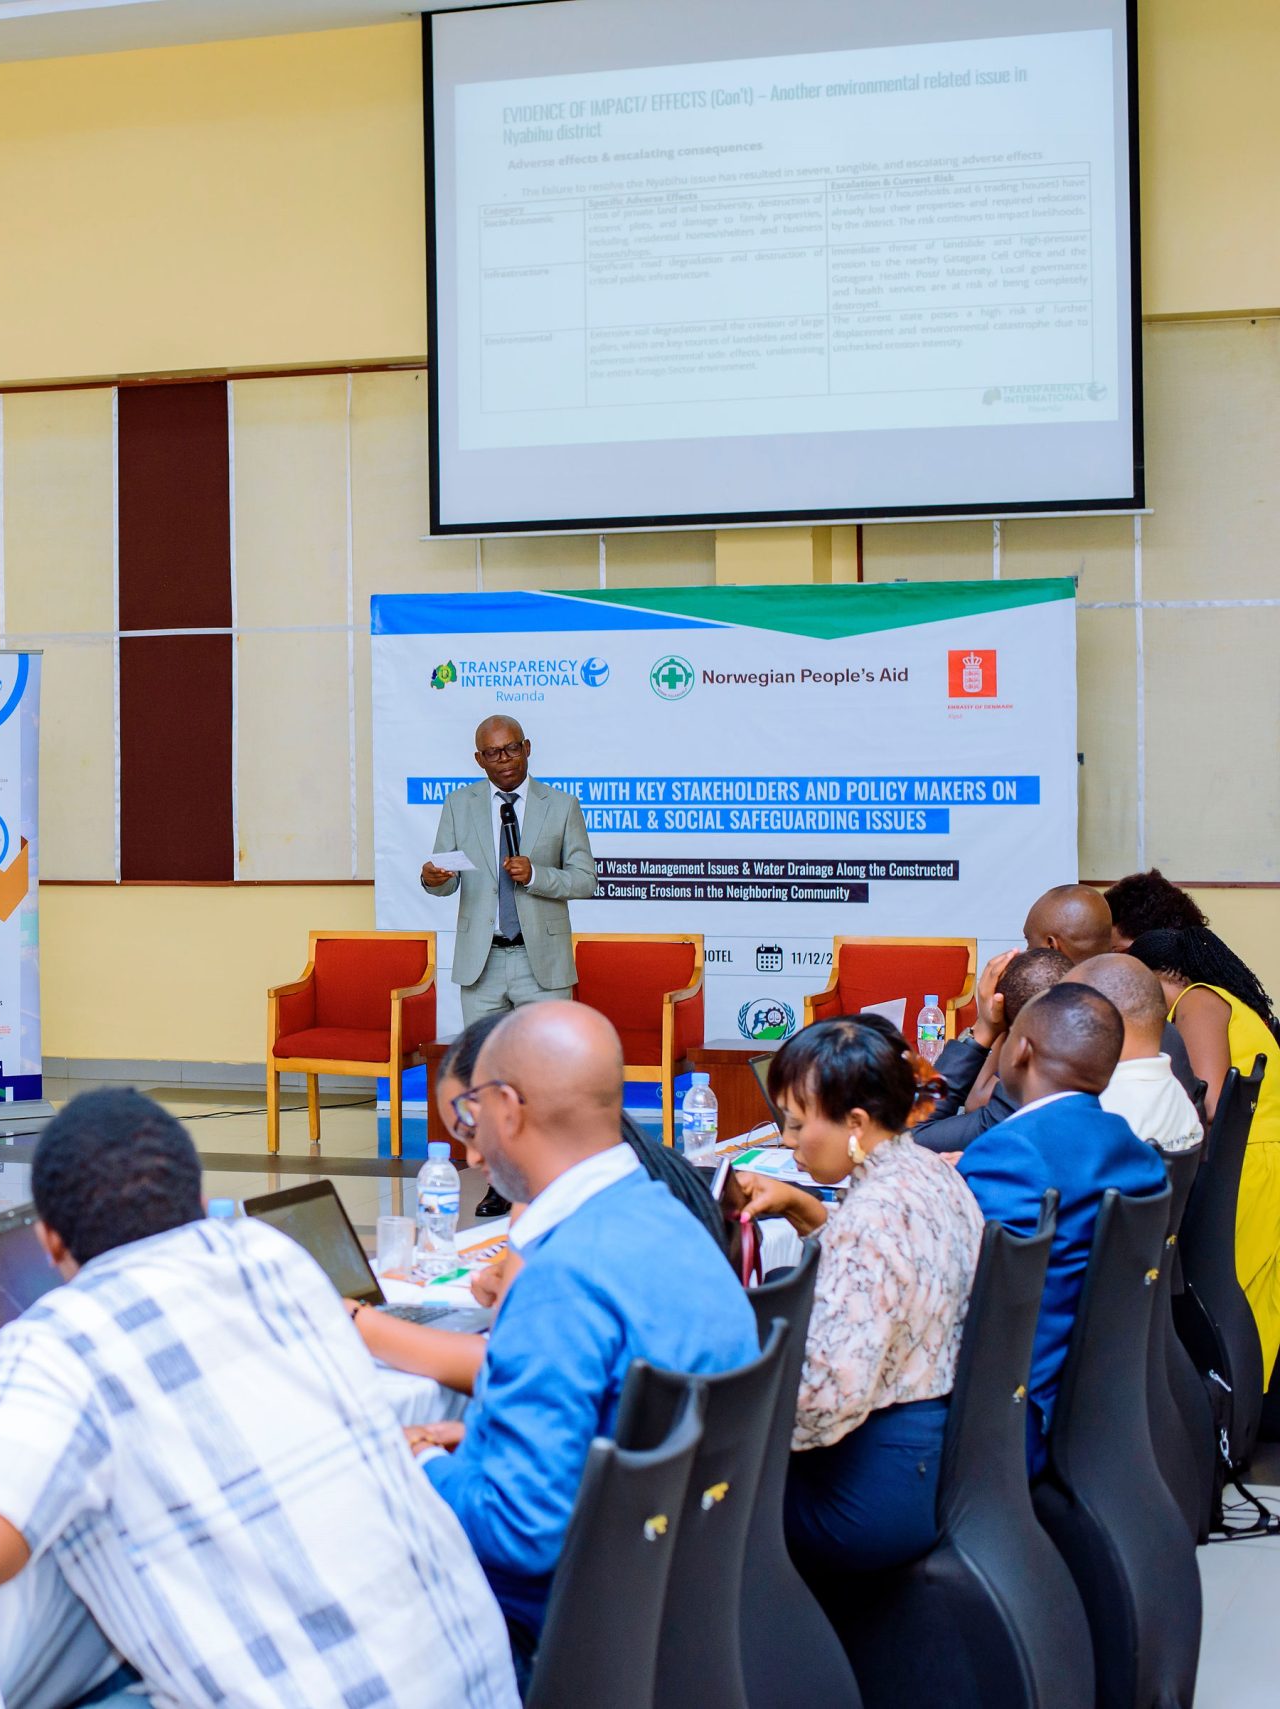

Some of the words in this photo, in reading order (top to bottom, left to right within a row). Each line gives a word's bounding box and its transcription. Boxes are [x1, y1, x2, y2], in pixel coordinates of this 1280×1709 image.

[503, 102, 565, 124] EVIDENCE
[570, 100, 586, 118] OF
[590, 95, 646, 116] IMPACT/
[651, 91, 706, 111] EFFECTS
[770, 81, 821, 101] Another
[825, 73, 919, 97] environmental
[924, 68, 970, 89] related
[975, 66, 1009, 85] issue
[1014, 64, 1026, 82] in
[503, 125, 552, 146] Nyabihu
[556, 121, 602, 141] district
[508, 156, 554, 170] Adverse
[558, 152, 598, 165] effects
[602, 152, 609, 162] &
[613, 146, 674, 164] escalating
[677, 141, 763, 158] consequences
[521, 187, 539, 197] The
[542, 184, 571, 195] failure
[575, 184, 586, 193] to
[588, 180, 622, 191] resolve
[626, 178, 642, 189] the
[646, 175, 687, 189] Nyabihu
[690, 173, 716, 184] issue
[718, 171, 736, 181] has
[739, 168, 780, 180] resulted
[784, 167, 793, 177] in
[883, 159, 903, 170] and
[906, 155, 958, 171] escalating
[962, 152, 1003, 164] adverse
[1006, 149, 1042, 161] effects
[831, 179, 880, 189] Escalation
[892, 175, 931, 185] Current
[933, 174, 954, 182] Risk
[953, 184, 971, 194] and
[1062, 177, 1085, 187] have
[831, 206, 864, 219] already
[916, 199, 966, 213] properties
[969, 198, 987, 207] and
[992, 195, 1032, 208] required
[831, 222, 841, 232] by
[844, 220, 858, 229] the
[899, 217, 914, 225] The
[937, 212, 982, 224] continues
[985, 212, 994, 220] to
[997, 209, 1028, 221] impact
[459, 660, 578, 673] TRANSPARENCY
[461, 674, 579, 687] INTERNATIONAL
[702, 670, 795, 687] Norwegian
[801, 668, 874, 686] People's
[880, 667, 908, 682] Aid
[496, 691, 544, 702] Rwanda
[589, 782, 632, 800] WITH
[636, 782, 666, 801] KEY
[672, 782, 799, 800] STAKEHOLDERS
[805, 782, 840, 801] AND
[847, 781, 907, 801] POLICY
[914, 781, 986, 801] MAKERS
[992, 781, 1017, 801] ON
[647, 810, 658, 830] &
[665, 810, 724, 830] SOCIAL
[730, 811, 859, 831] SAFEGUARDING
[866, 811, 926, 831] ISSUES
[606, 861, 637, 874] Waste
[640, 861, 704, 877] Management
[707, 862, 739, 876] Issues
[742, 863, 751, 875] &
[754, 862, 785, 875] Water
[787, 863, 834, 878] Drainage
[836, 863, 866, 878] Along
[869, 863, 885, 877] the
[889, 863, 953, 877] Constructed
[608, 884, 647, 899] Causing
[650, 885, 692, 898] Erosions
[694, 885, 704, 898] in
[706, 885, 723, 898] the
[726, 886, 788, 900] Neighboring
[791, 886, 849, 901] Community
[792, 952, 832, 965] 11/12/2
